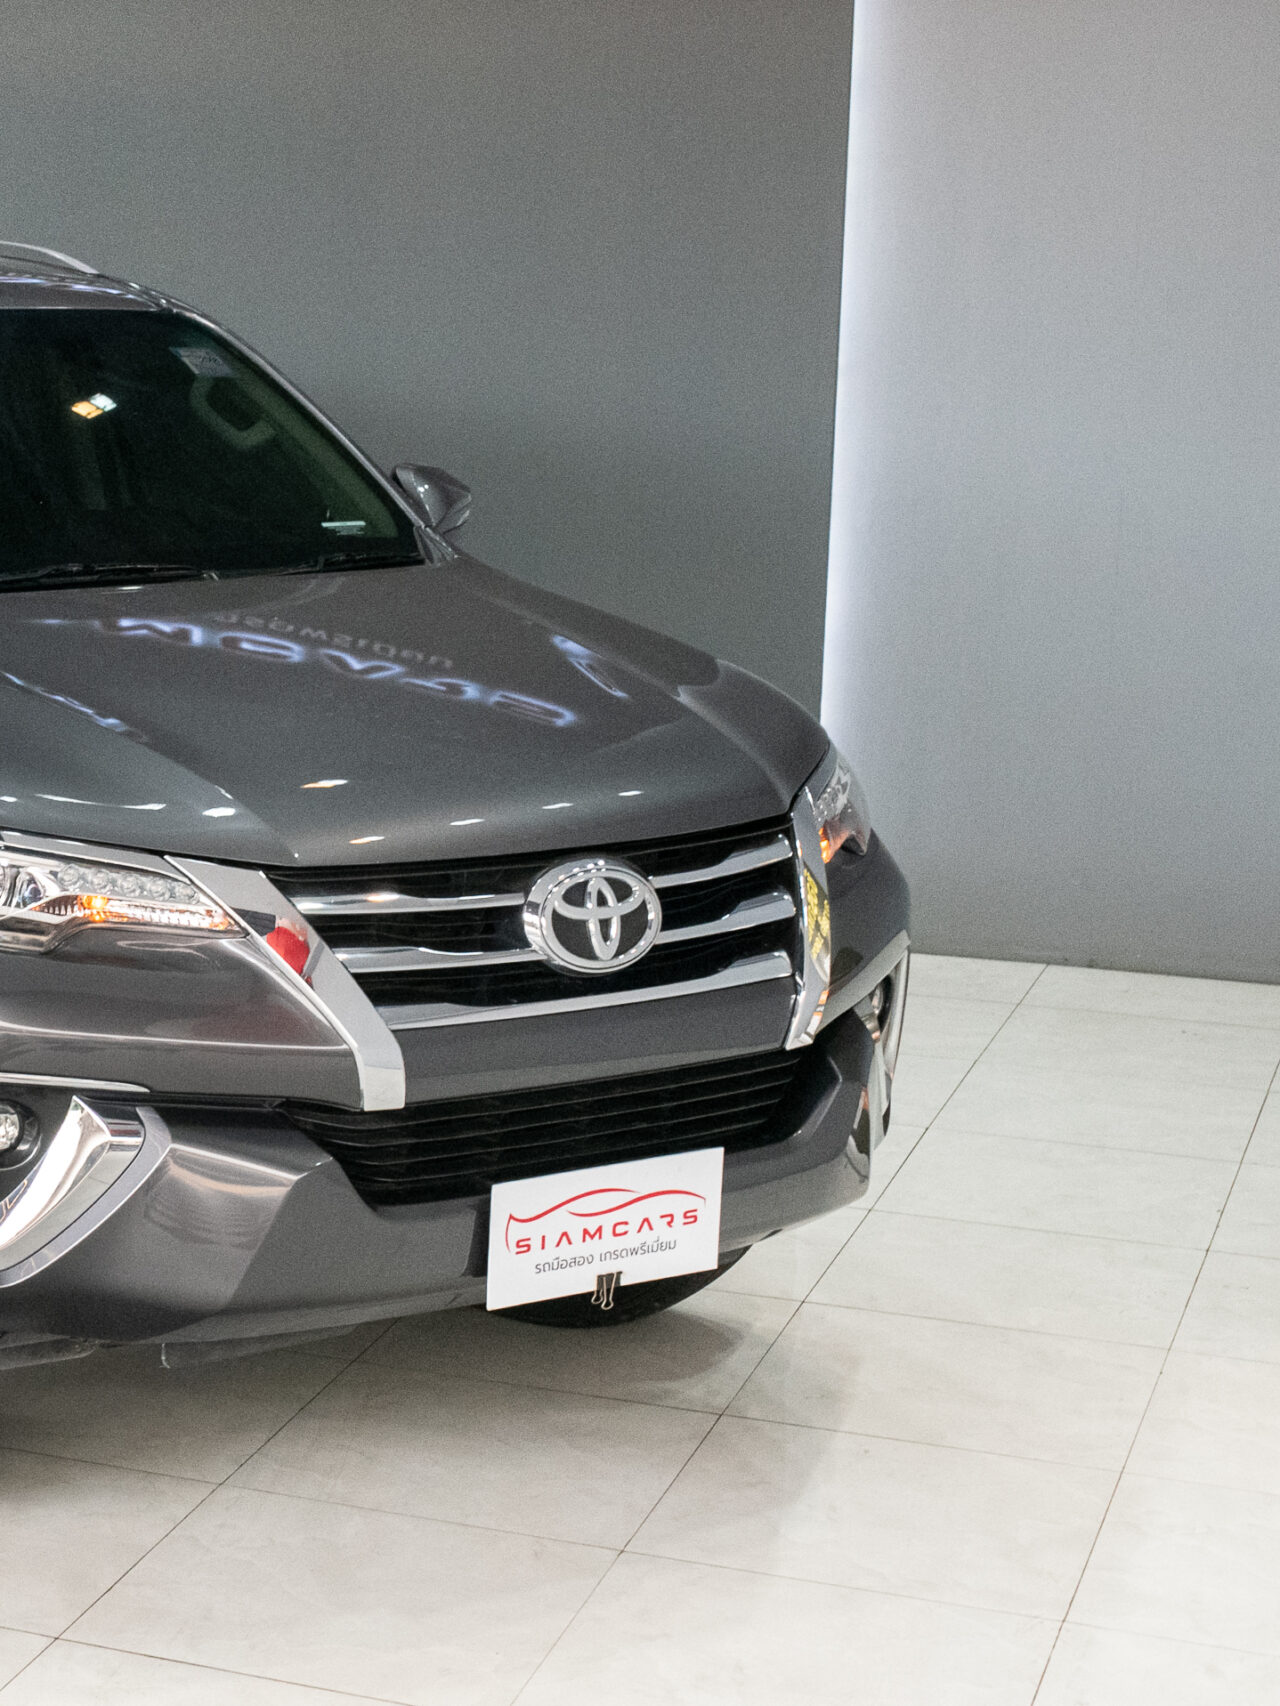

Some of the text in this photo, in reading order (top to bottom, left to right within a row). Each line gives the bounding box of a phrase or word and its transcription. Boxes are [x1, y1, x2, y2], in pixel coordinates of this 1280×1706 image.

[515, 1208, 698, 1255] SIAMCARS
[534, 1255, 595, 1275] รถมือสอง
